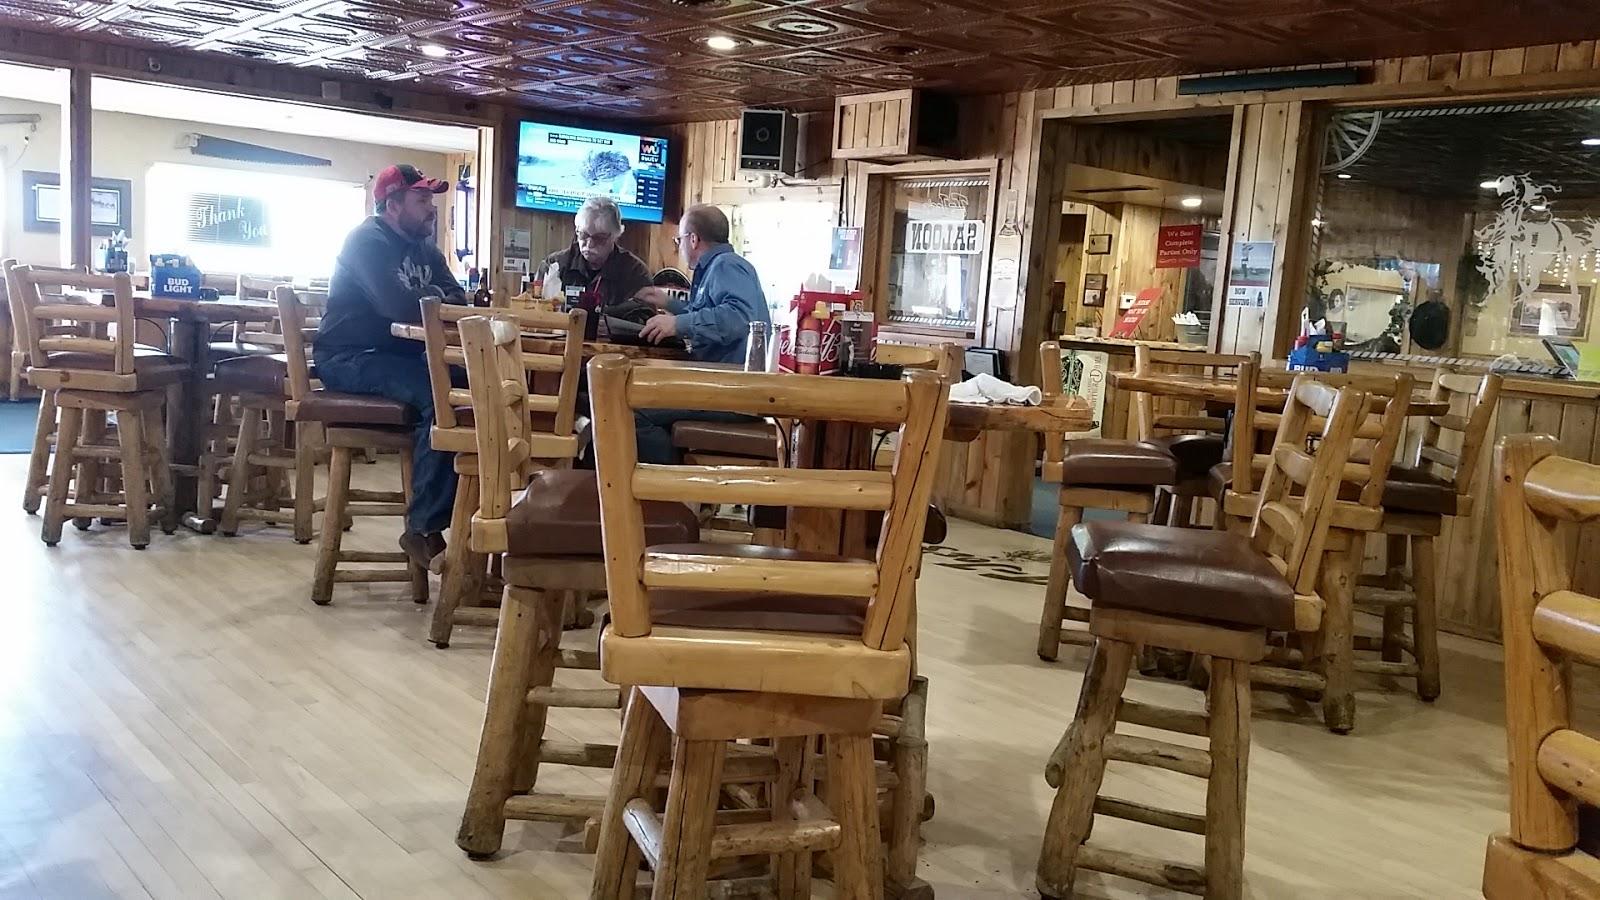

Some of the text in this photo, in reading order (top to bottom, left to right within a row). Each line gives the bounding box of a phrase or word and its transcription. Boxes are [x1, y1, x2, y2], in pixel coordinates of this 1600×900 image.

[197, 197, 244, 228] Thank
[240, 220, 267, 240] You
[1181, 248, 1198, 256] Only
[168, 278, 189, 286] BUD
[163, 284, 193, 294] LIGHT
